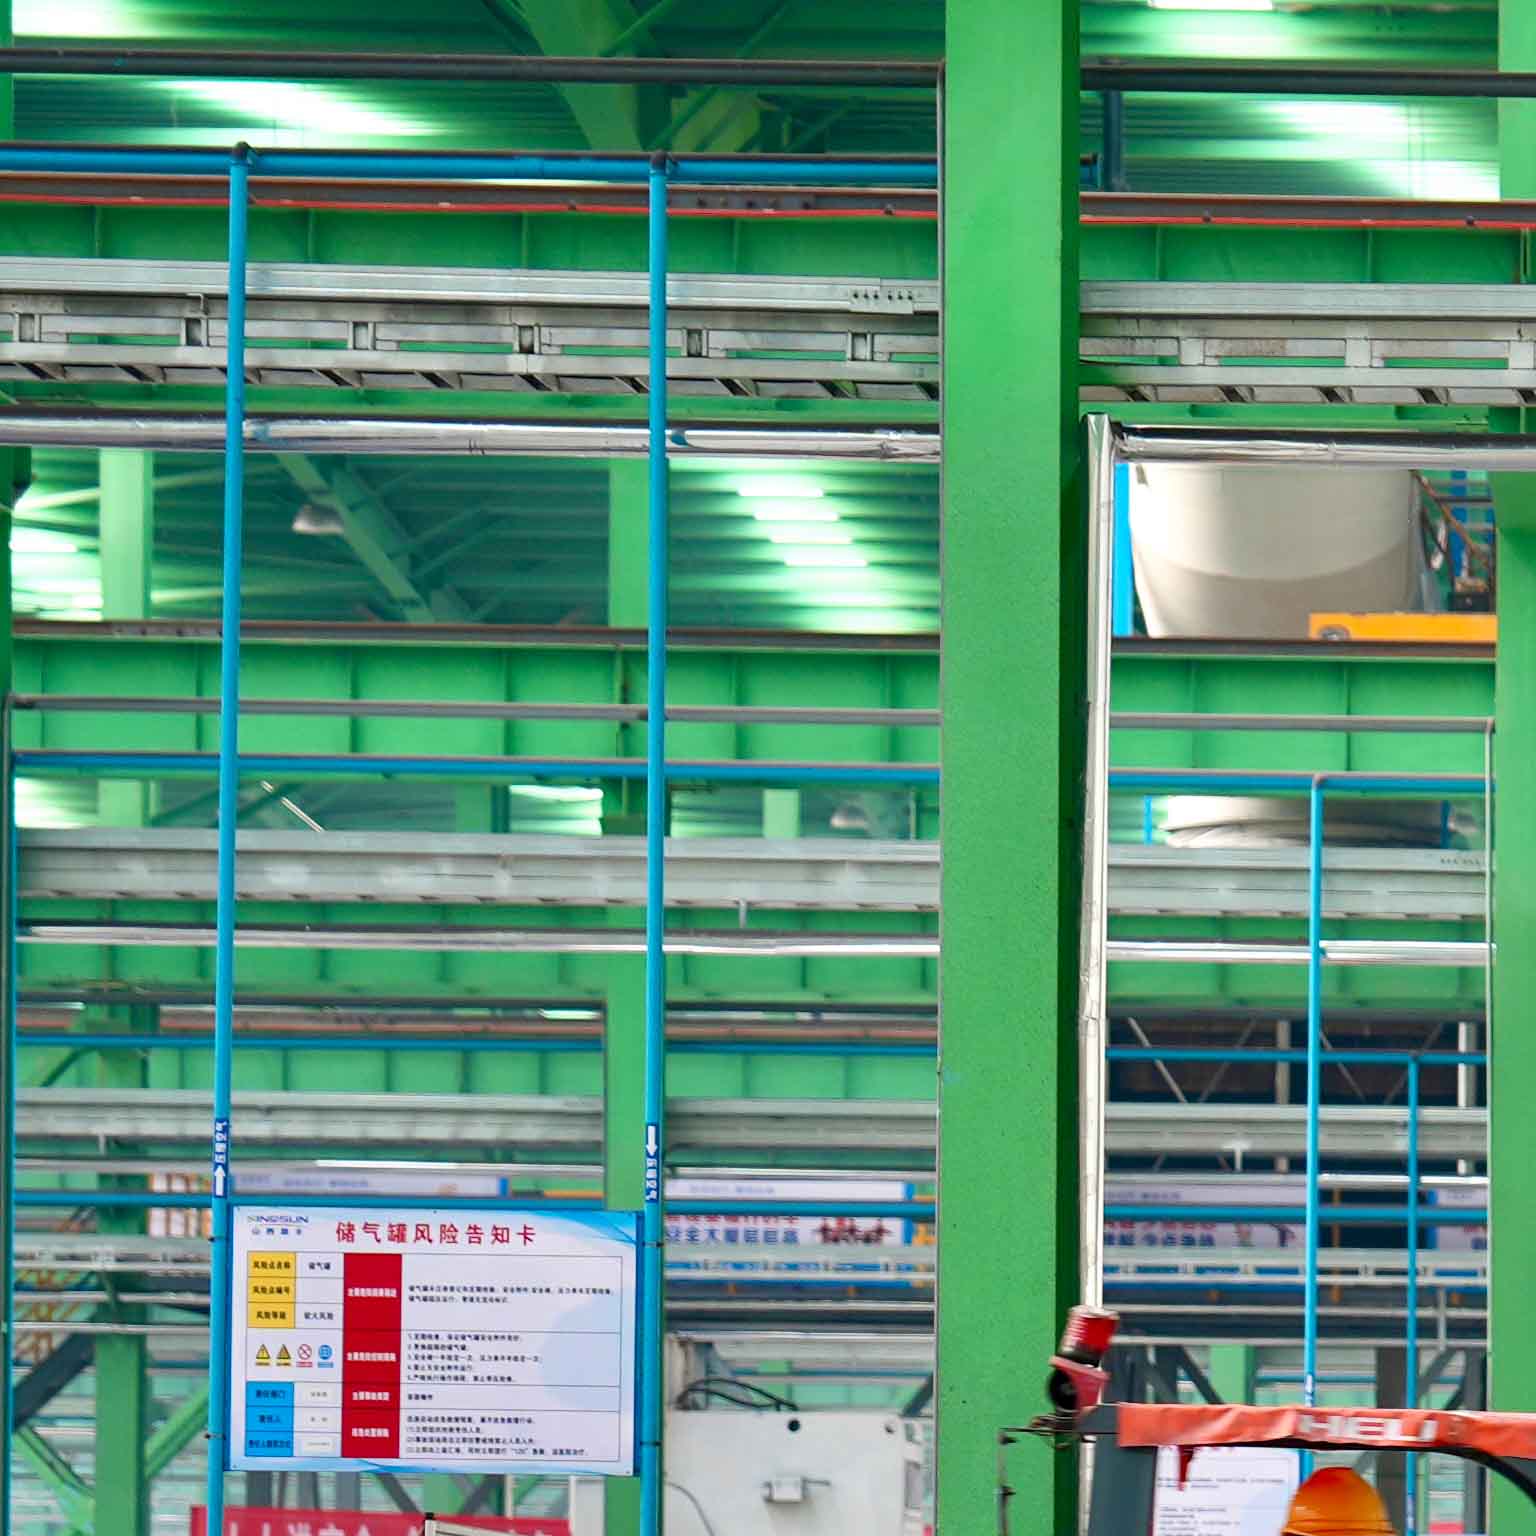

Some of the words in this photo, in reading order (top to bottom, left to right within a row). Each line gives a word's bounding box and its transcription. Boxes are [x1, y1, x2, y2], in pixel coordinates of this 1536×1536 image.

[336, 1221, 537, 1246] 储气罐风险告知卡
[1297, 1413, 1439, 1442] HELI
